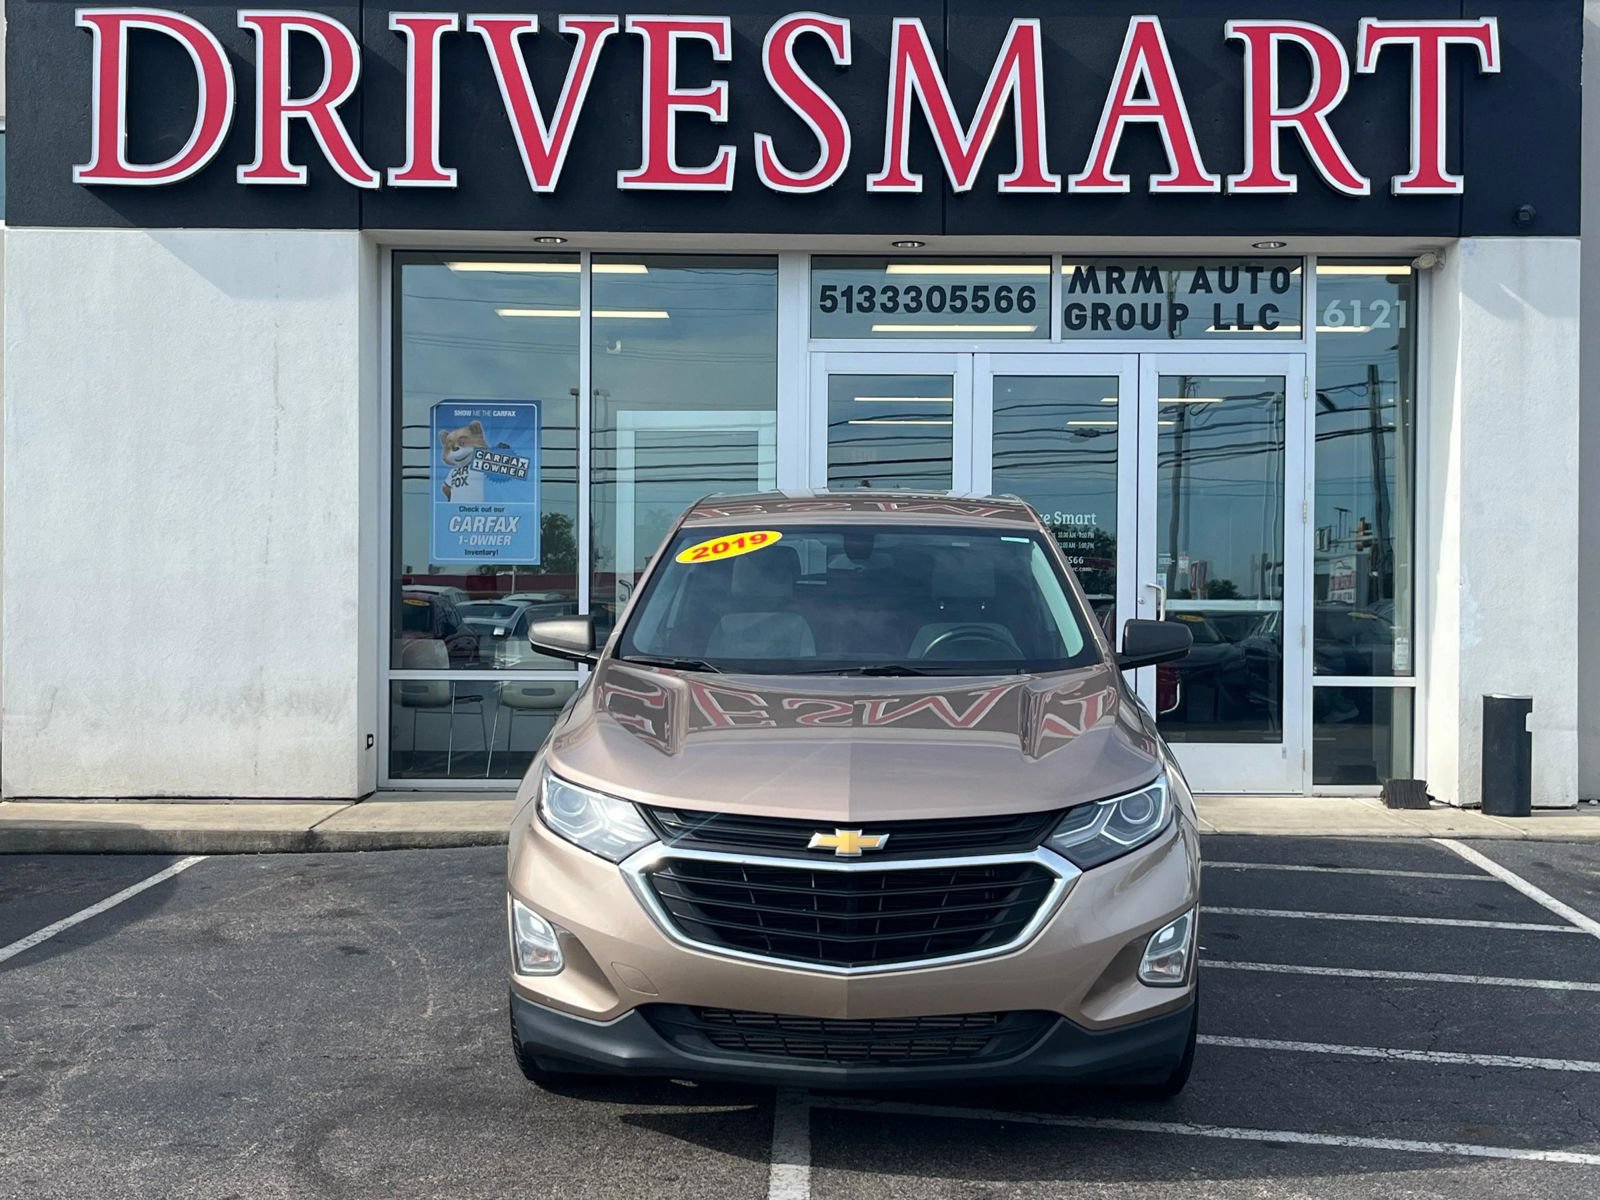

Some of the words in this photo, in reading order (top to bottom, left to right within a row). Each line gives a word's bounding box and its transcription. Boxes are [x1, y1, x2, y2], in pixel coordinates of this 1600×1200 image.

[72, 8, 1501, 195] DRIVESMART
[1068, 266, 1164, 294] MRM
[1188, 266, 1291, 294] AUTO
[819, 285, 1036, 314] 5133305566
[1064, 303, 1190, 331] GROUP
[1213, 303, 1280, 331] LLC
[1323, 299, 1407, 328] 6121
[475, 449, 529, 469] CARFAX
[448, 515, 520, 533] CARFAX
[1054, 511, 1097, 525] Smart
[458, 535, 512, 546] 1-OWNER
[464, 549, 499, 557] Inventory!
[692, 533, 768, 560] 2019
